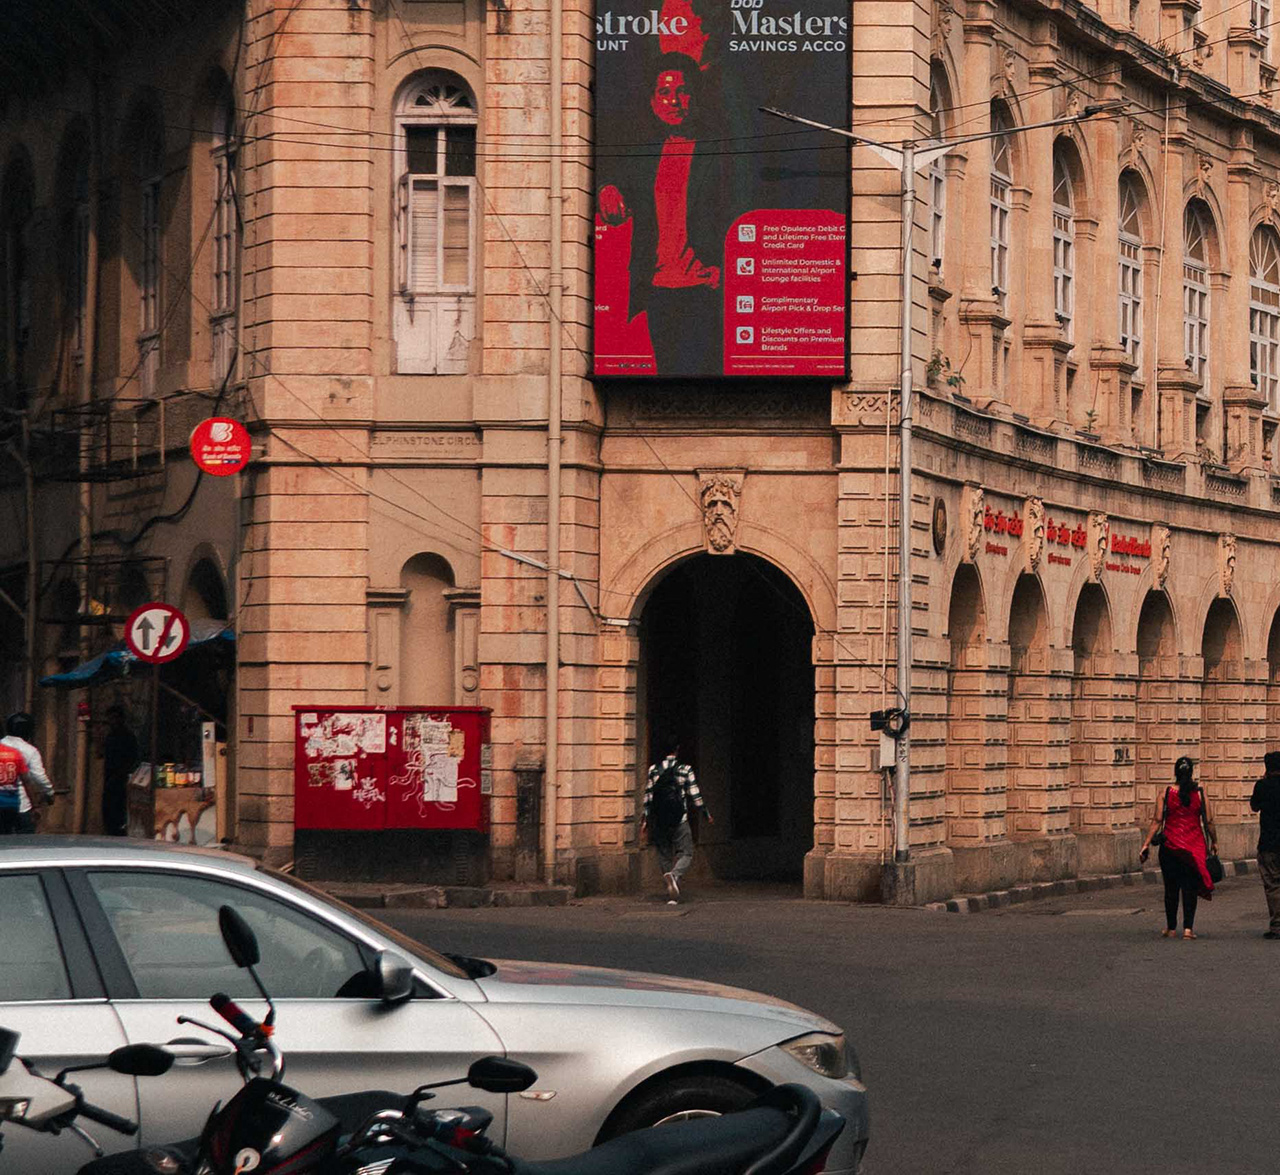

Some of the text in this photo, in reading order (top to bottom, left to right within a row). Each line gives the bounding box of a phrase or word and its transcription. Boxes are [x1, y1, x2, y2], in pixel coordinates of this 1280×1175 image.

[596, 10, 688, 35] stroke
[731, 10, 847, 36] Masters
[596, 40, 629, 51] UNT
[729, 40, 846, 52] SAVINGS ACCO
[810, 267, 836, 275] Airport
[761, 296, 818, 304] Complimentary
[761, 305, 787, 313] Airport
[761, 327, 792, 335] Lifestyle
[372, 436, 445, 445] ELPHINSTONE
